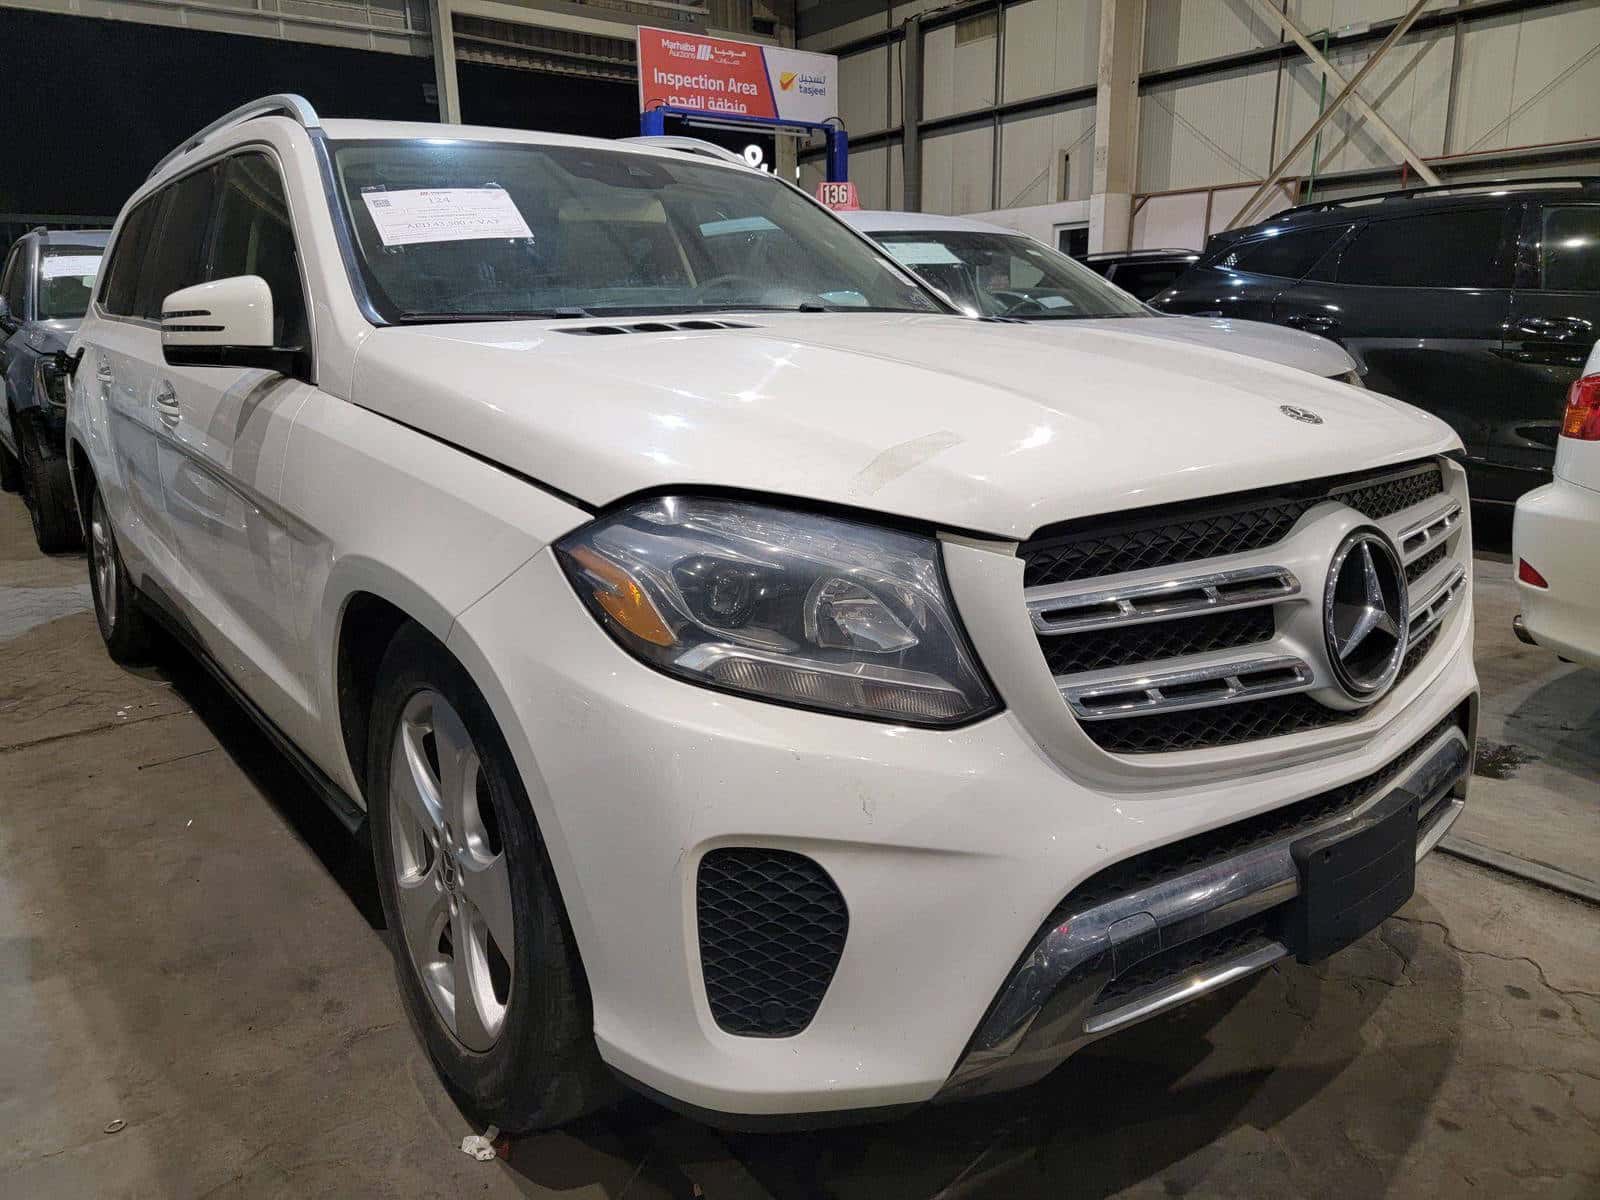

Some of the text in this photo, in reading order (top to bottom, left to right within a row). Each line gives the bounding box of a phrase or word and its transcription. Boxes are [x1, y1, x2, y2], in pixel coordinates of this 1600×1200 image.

[661, 38, 696, 52] Marhaba
[653, 68, 758, 96] Inspection Area
[798, 84, 826, 97] tasjeel
[707, 96, 747, 114] منطقة
[823, 184, 848, 204] 136
